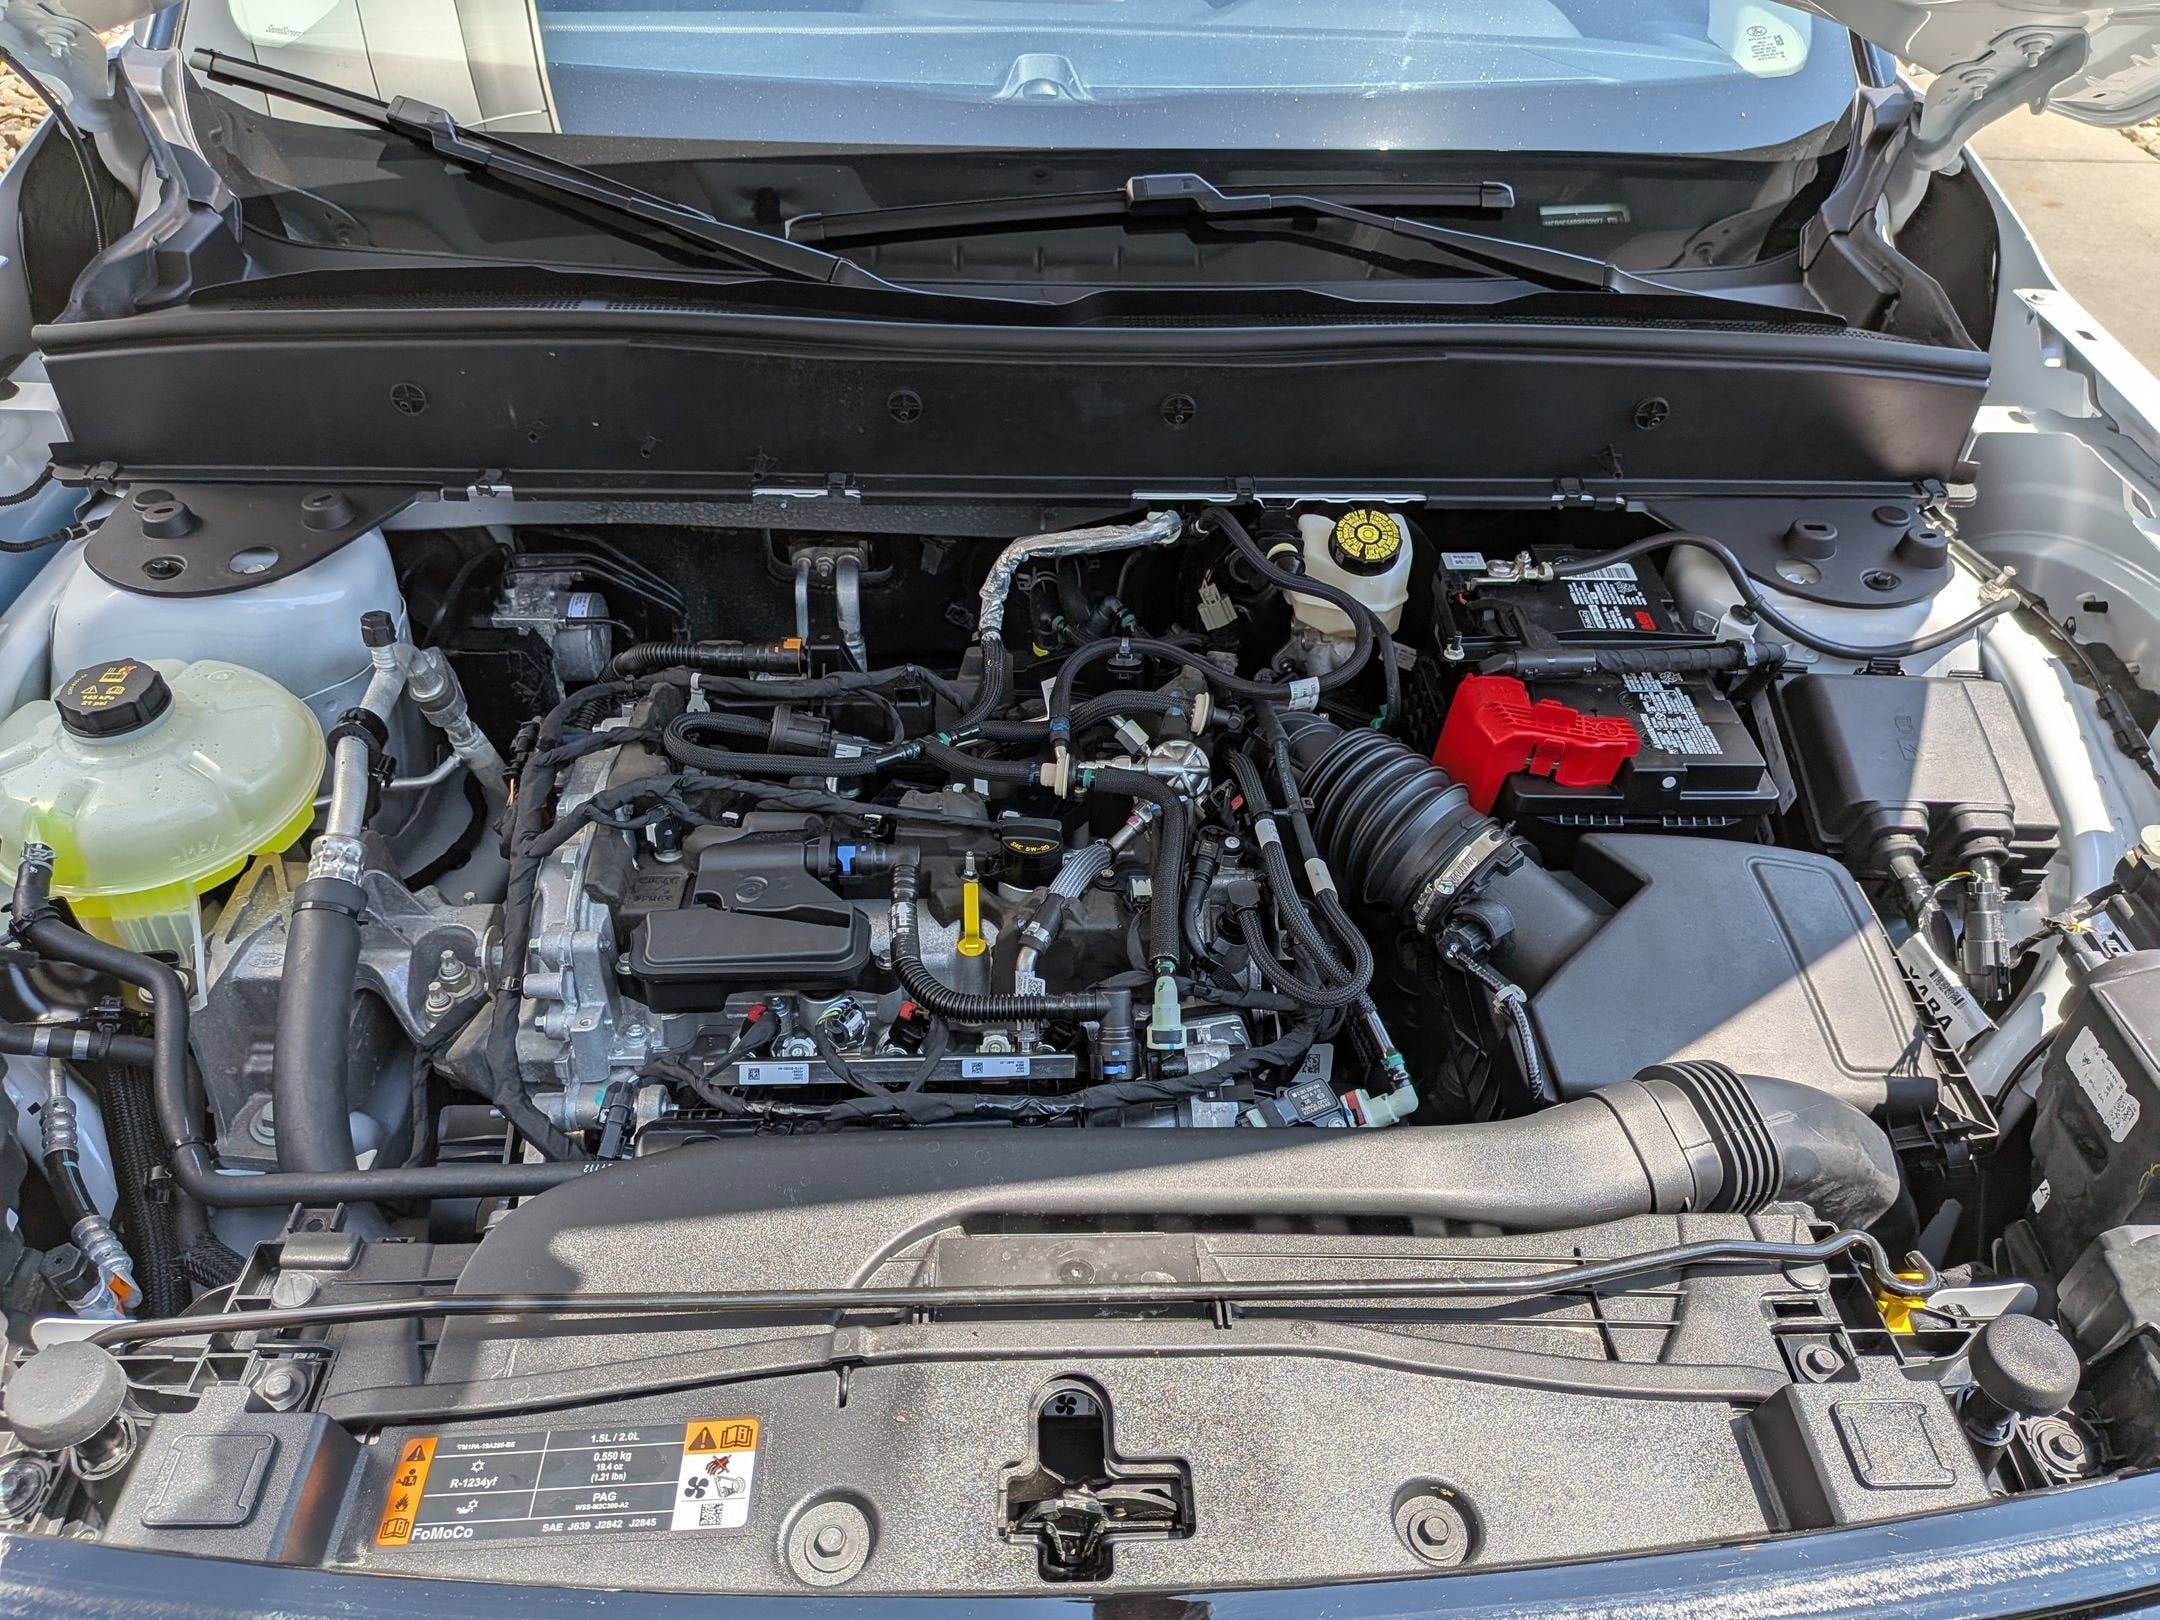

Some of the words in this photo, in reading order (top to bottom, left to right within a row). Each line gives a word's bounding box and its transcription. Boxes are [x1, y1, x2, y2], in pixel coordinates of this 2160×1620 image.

[590, 1433, 611, 1443] 1.5L
[618, 1431, 641, 1441] 2.0L
[593, 1451, 618, 1462] 0.550
[619, 1450, 632, 1462] kg
[595, 1463, 612, 1471] 19.4
[449, 1476, 499, 1489] R-1234yf
[590, 1473, 610, 1483] (1.21
[611, 1471, 627, 1482] lbs)
[592, 1491, 617, 1502] PAG
[541, 1522, 564, 1533] SAE
[567, 1521, 591, 1531] J639
[594, 1519, 623, 1530] J2842
[628, 1518, 657, 1528] J2845
[411, 1525, 474, 1541] FoMoCo
